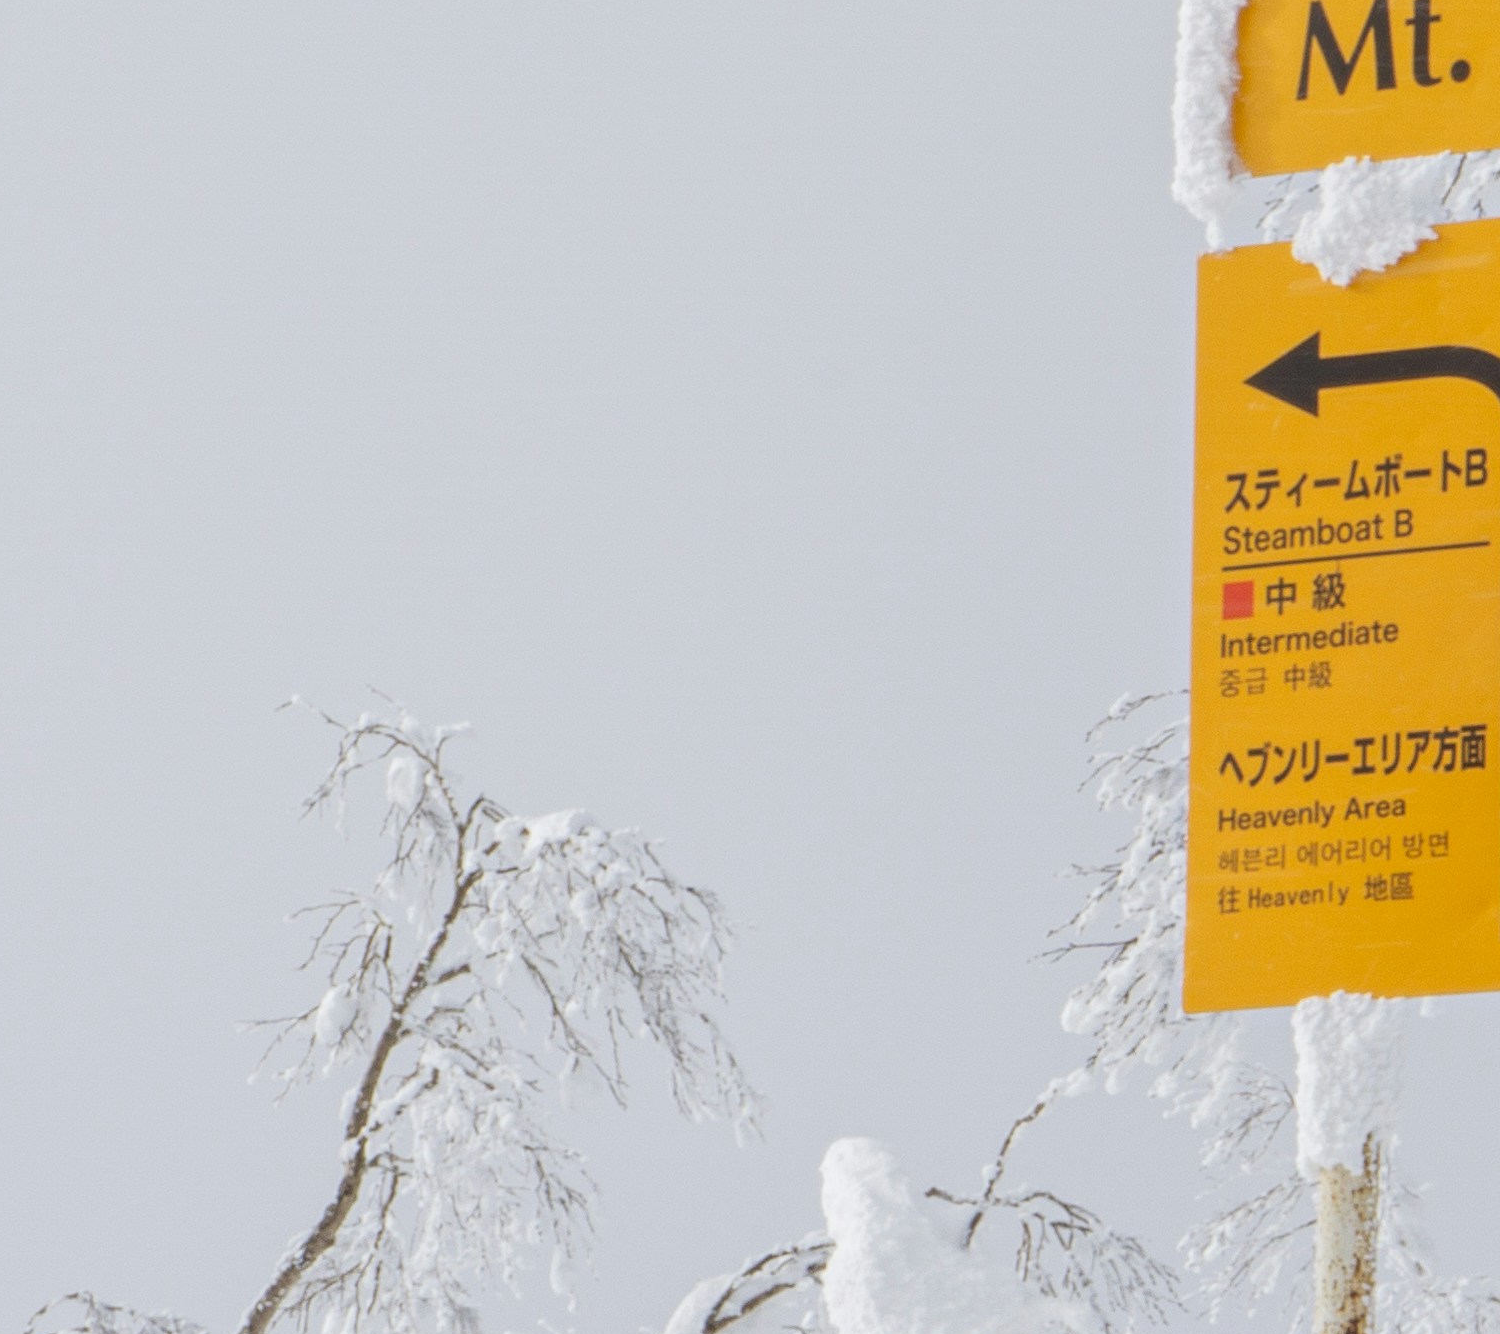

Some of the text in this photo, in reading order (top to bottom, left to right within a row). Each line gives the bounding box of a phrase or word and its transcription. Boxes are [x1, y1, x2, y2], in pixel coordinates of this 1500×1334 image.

[1223, 509, 1414, 555] Steamboat B
[1220, 620, 1399, 659] Intermediate
[1220, 660, 1332, 698] 중급 中級
[1219, 723, 1487, 787] ヘブンリーエリア方面
[1218, 797, 1407, 832] Heavenly Area
[1297, 835, 1392, 866] 에어리어
[1402, 831, 1450, 859] 방면
[1248, 881, 1349, 909] Heavenly
